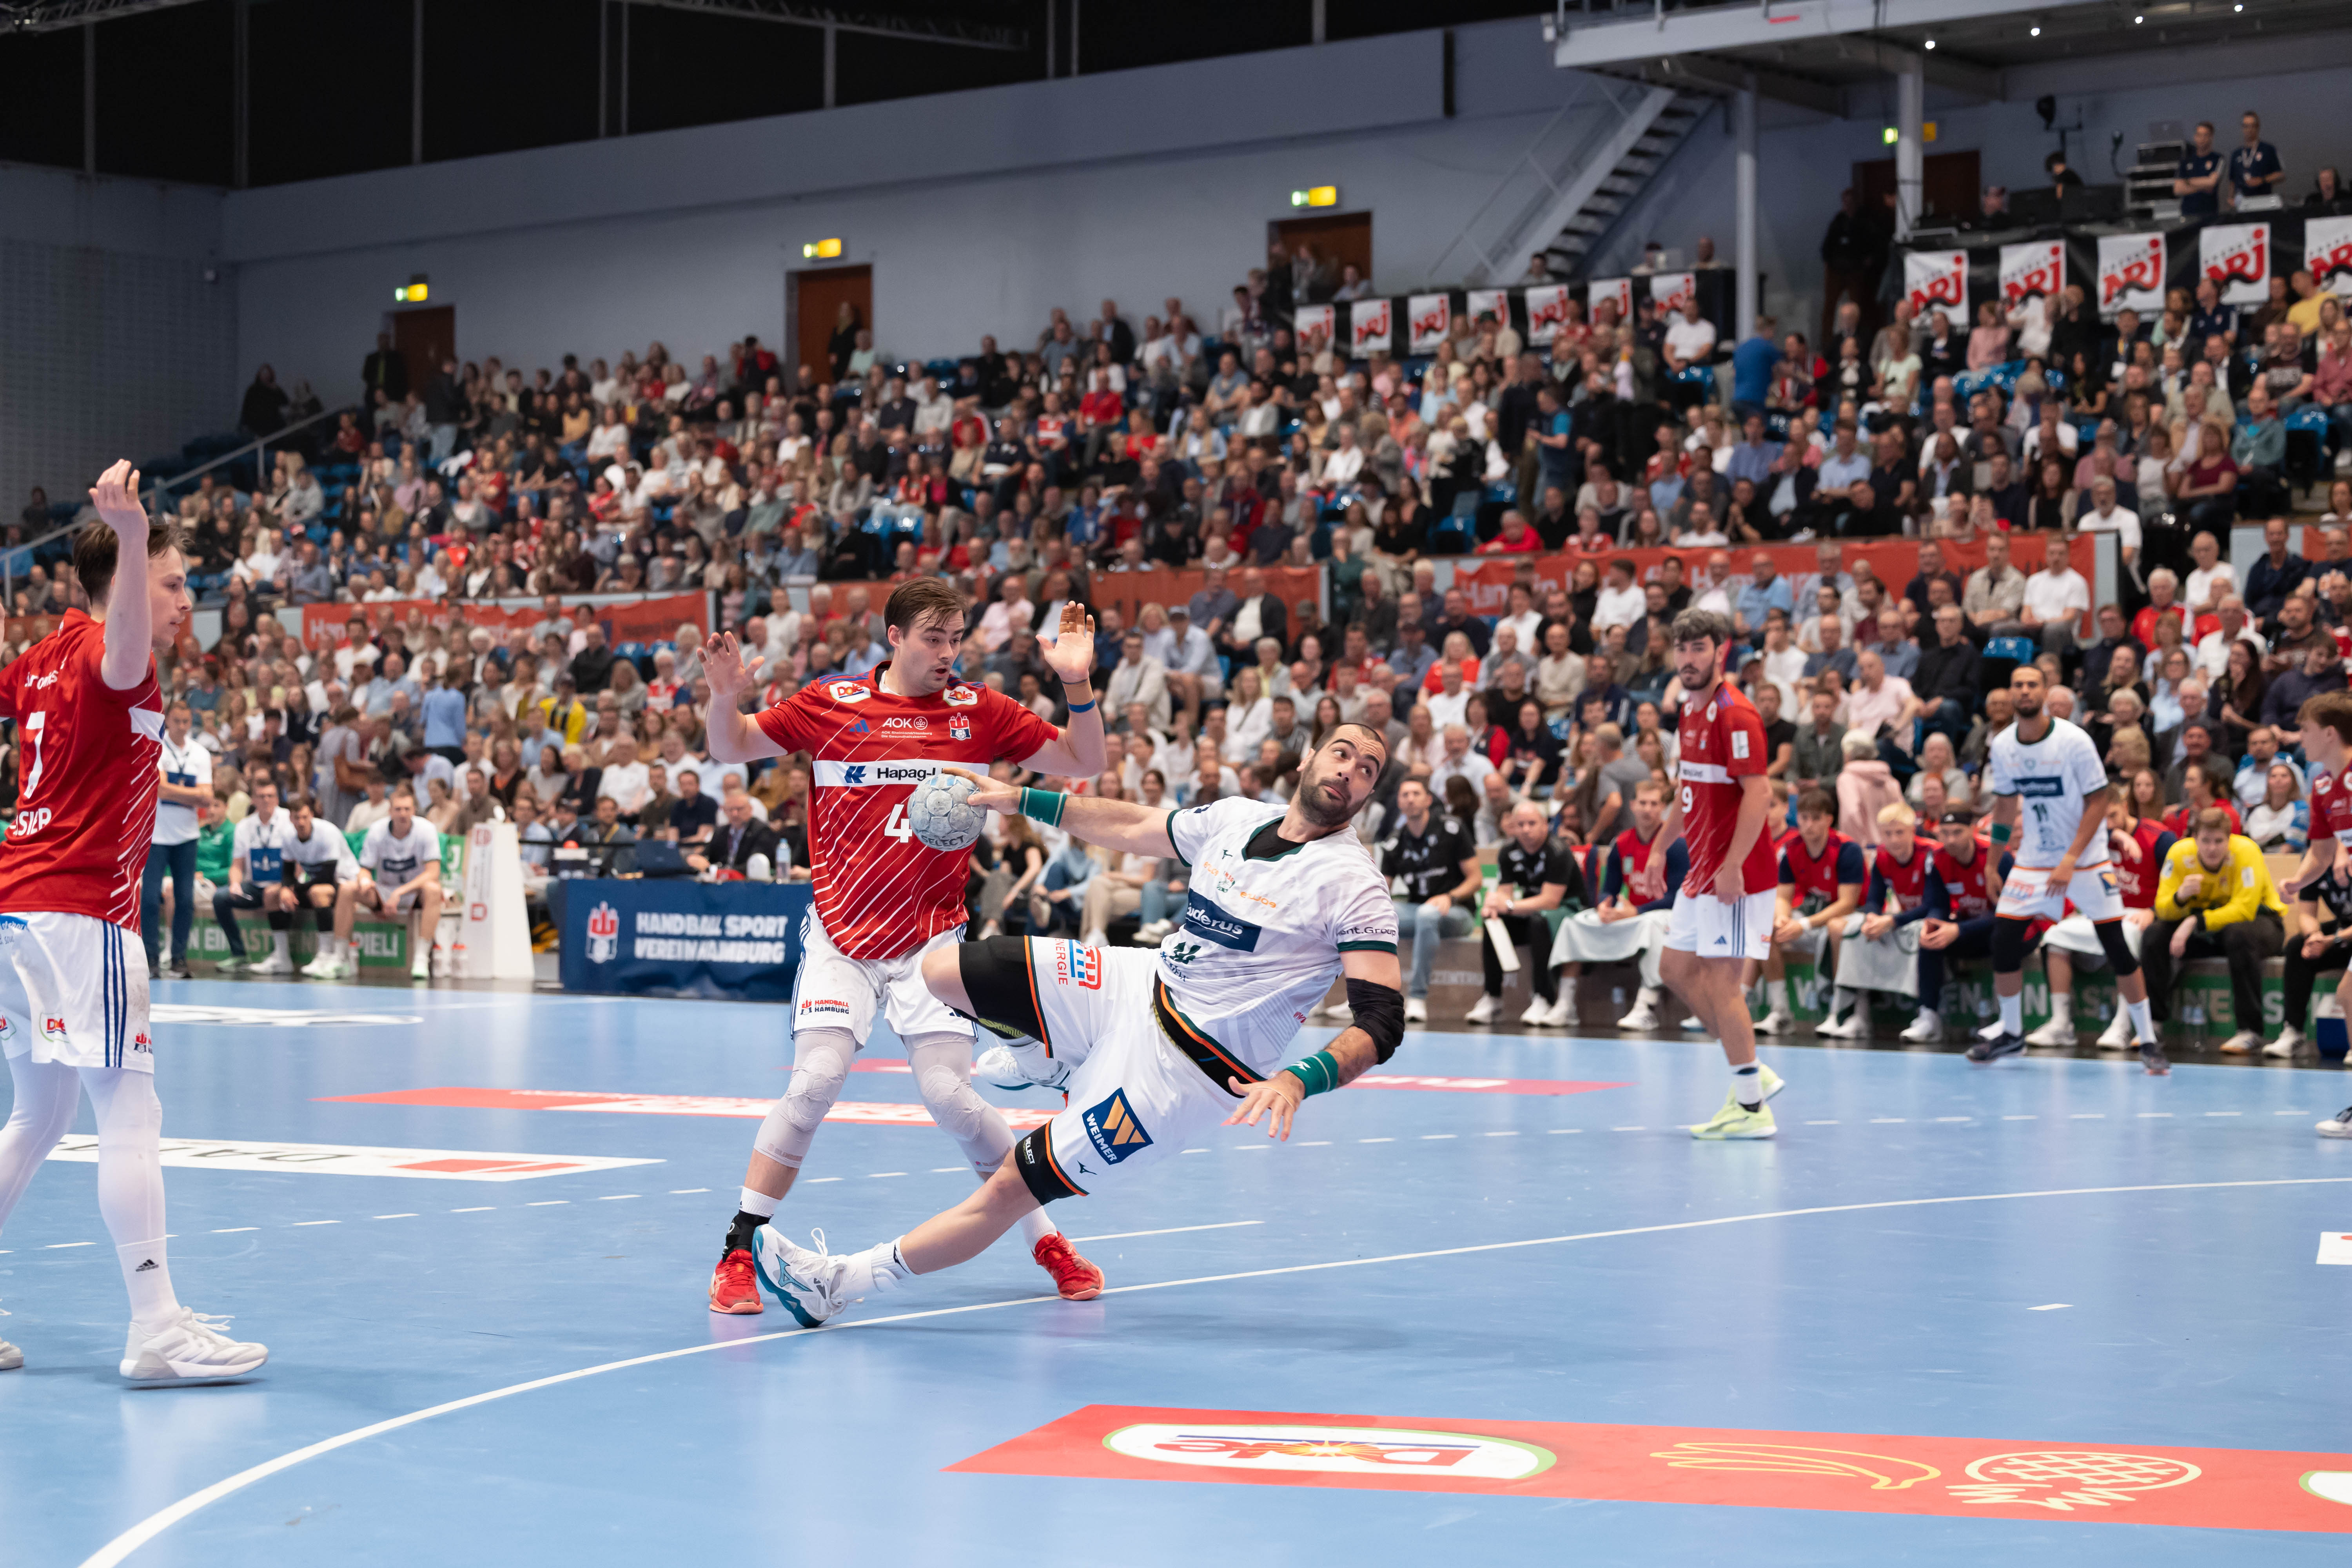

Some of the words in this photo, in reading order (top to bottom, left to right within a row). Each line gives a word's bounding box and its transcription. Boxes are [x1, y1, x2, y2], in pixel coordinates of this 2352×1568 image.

[882, 717, 913, 728] AOK
[884, 804, 913, 843] 4
[921, 835, 964, 846] SELECT
[635, 911, 722, 936] HANDBALL
[724, 914, 788, 938] SPORT
[815, 999, 849, 1007] HANDBALL
[1025, 1136, 1035, 1164] SELECT
[1086, 1112, 1117, 1161] WEIMER
[1152, 1439, 1478, 1467] Dole
